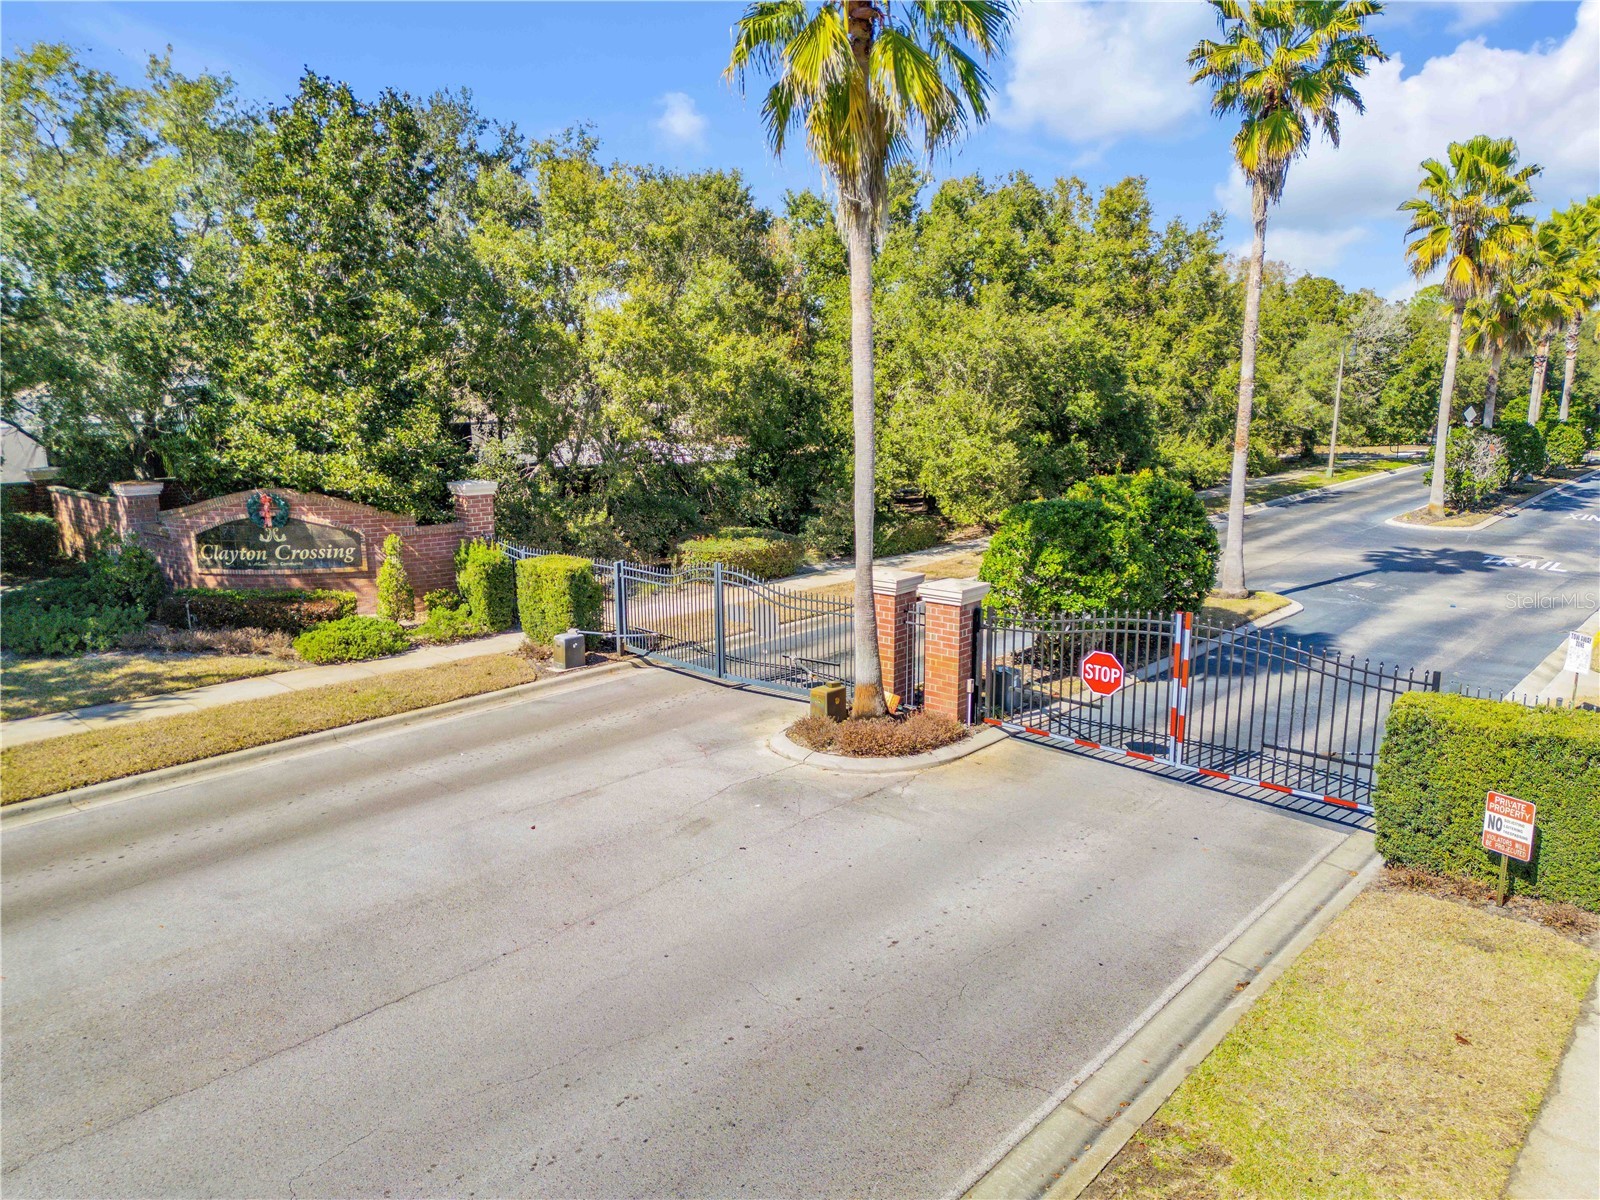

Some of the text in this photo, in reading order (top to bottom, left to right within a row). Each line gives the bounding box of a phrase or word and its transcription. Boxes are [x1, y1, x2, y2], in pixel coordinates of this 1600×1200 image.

[200, 543, 357, 566] Clayton Crossing
[1482, 555, 1568, 573] TRAIL
[1084, 663, 1121, 684] STOP
[1489, 802, 1531, 821] PROPERTY
[1494, 795, 1527, 813] PRIVATE
[1487, 814, 1503, 832] NO
[1485, 839, 1493, 847] BE
[1486, 833, 1513, 847] VIOLATORS
